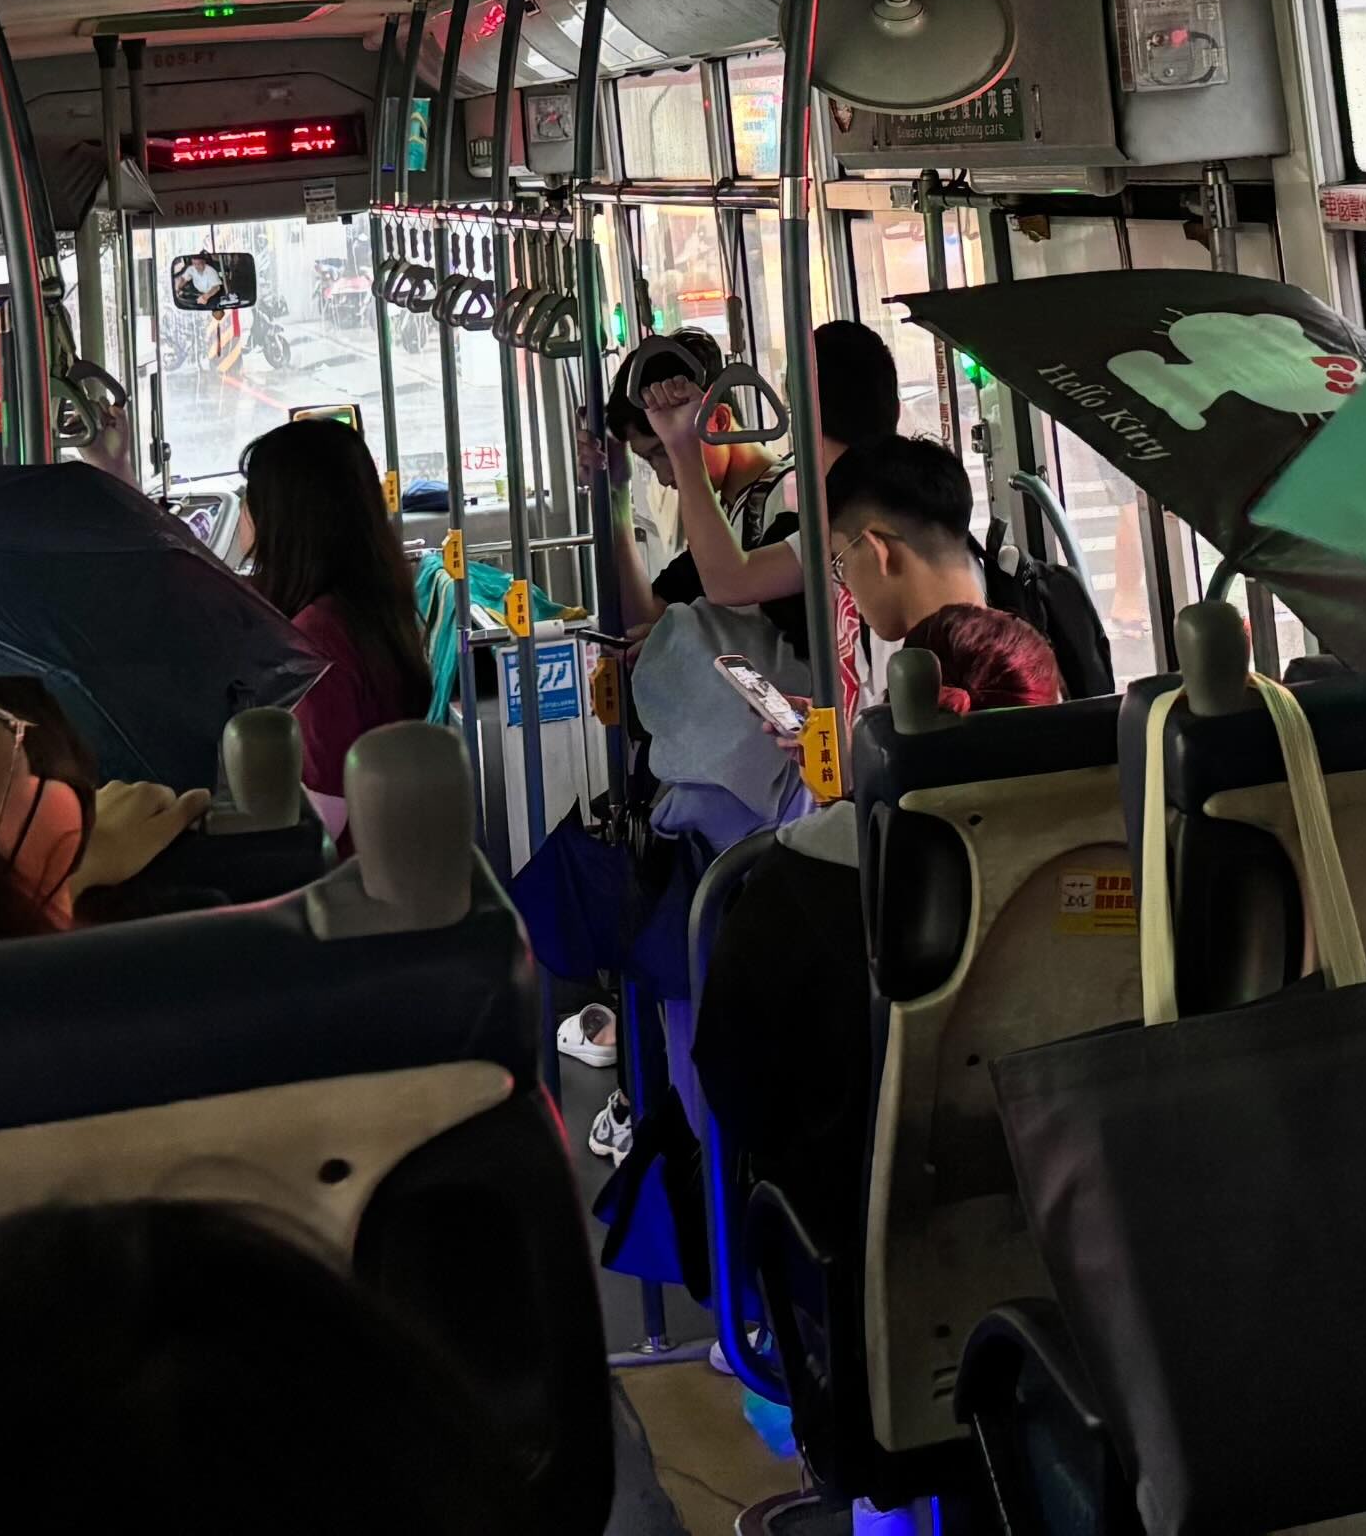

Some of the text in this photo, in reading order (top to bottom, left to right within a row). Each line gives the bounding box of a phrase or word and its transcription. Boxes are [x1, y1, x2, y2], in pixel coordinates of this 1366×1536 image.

[985, 122, 1005, 136] cars
[1037, 363, 1172, 461] Hello Kitty
[818, 730, 835, 784] 下車鈴
